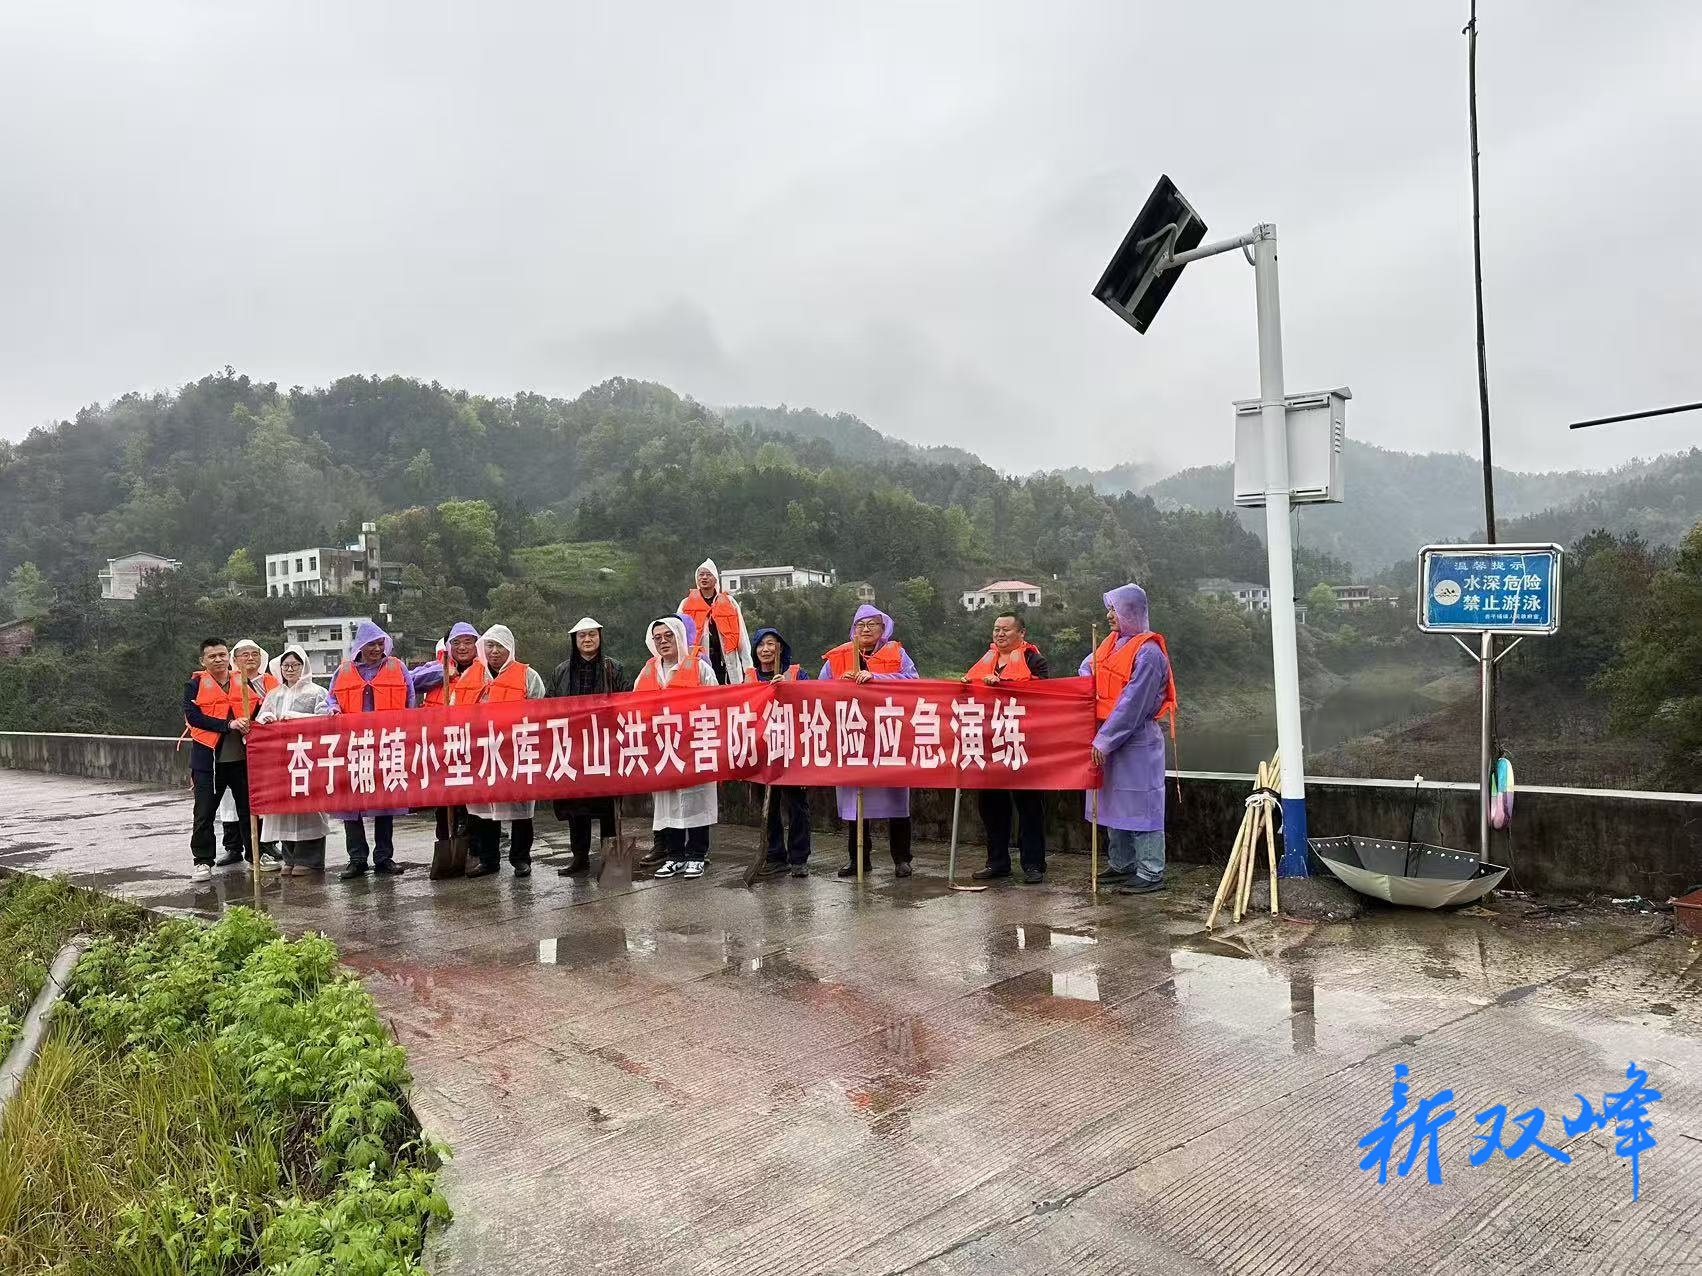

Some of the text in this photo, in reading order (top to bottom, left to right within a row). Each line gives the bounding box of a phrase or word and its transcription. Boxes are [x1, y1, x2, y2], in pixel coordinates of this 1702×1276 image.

[1463, 574, 1542, 591] 水深危险
[1462, 595, 1542, 611] 禁止游泳
[286, 696, 1029, 797] 杏子铺镇小型水库及山洪灾害防御抢险应急演练
